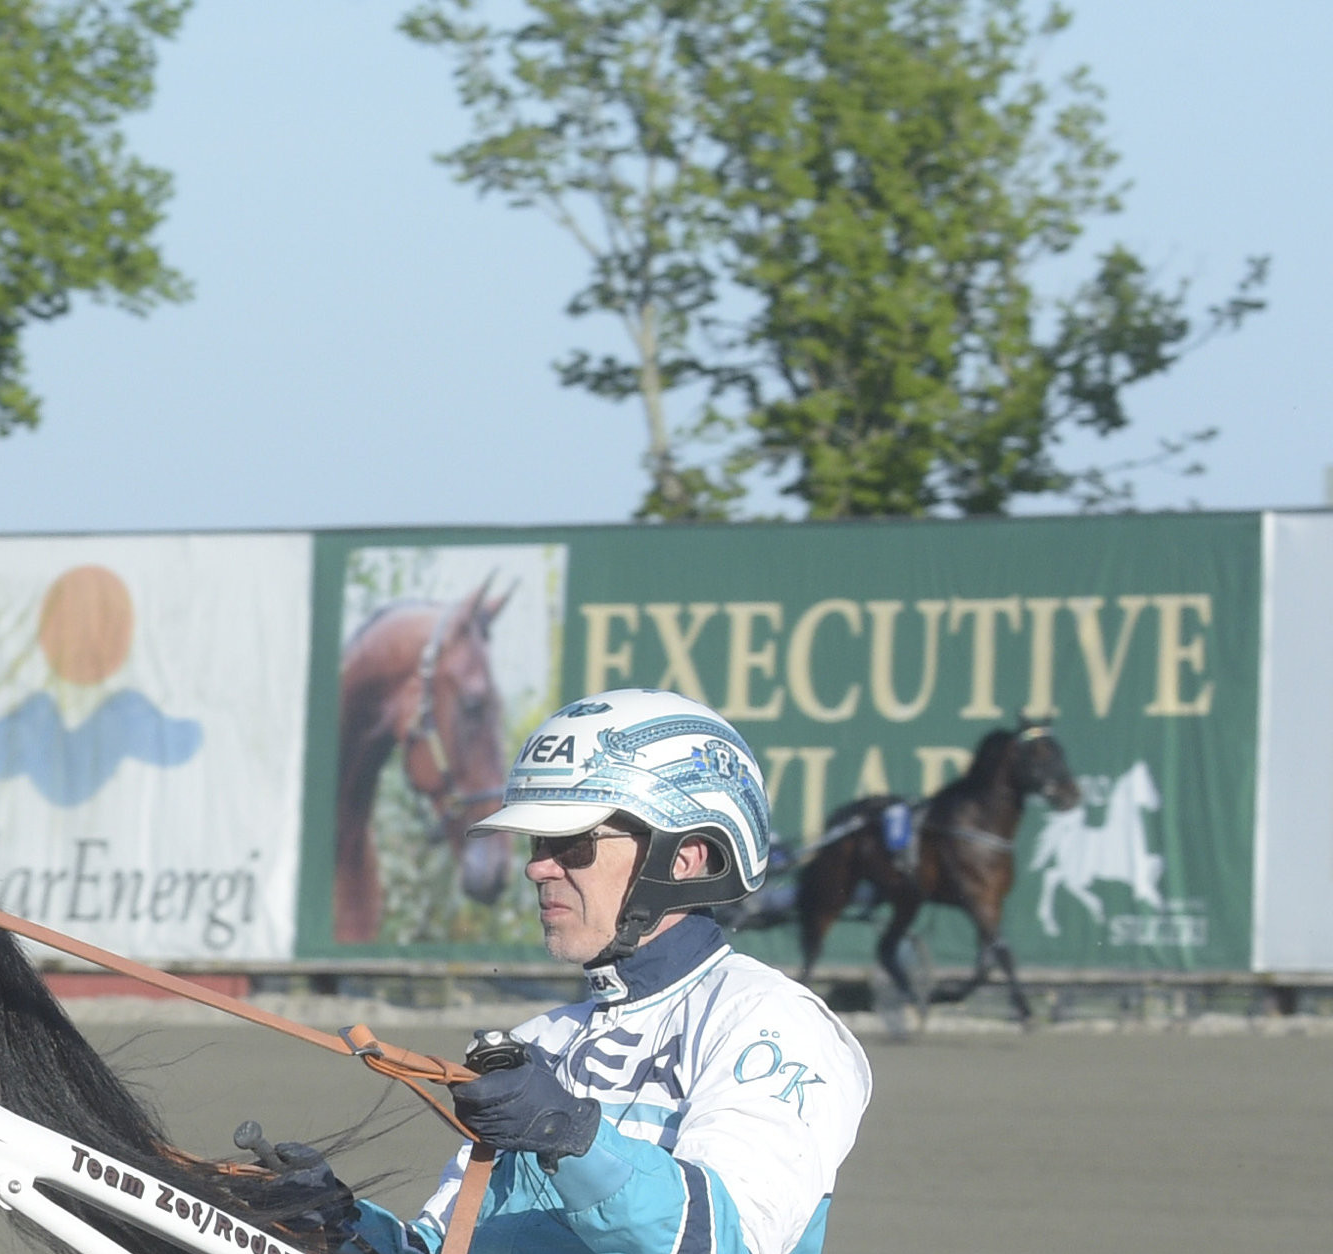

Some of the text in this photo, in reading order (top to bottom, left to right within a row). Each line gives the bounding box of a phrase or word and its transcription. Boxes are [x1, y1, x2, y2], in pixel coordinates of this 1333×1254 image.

[581, 594, 1215, 722] EXECUTIVE
[538, 1027, 685, 1100] EA
[71, 1144, 146, 1200] Team
